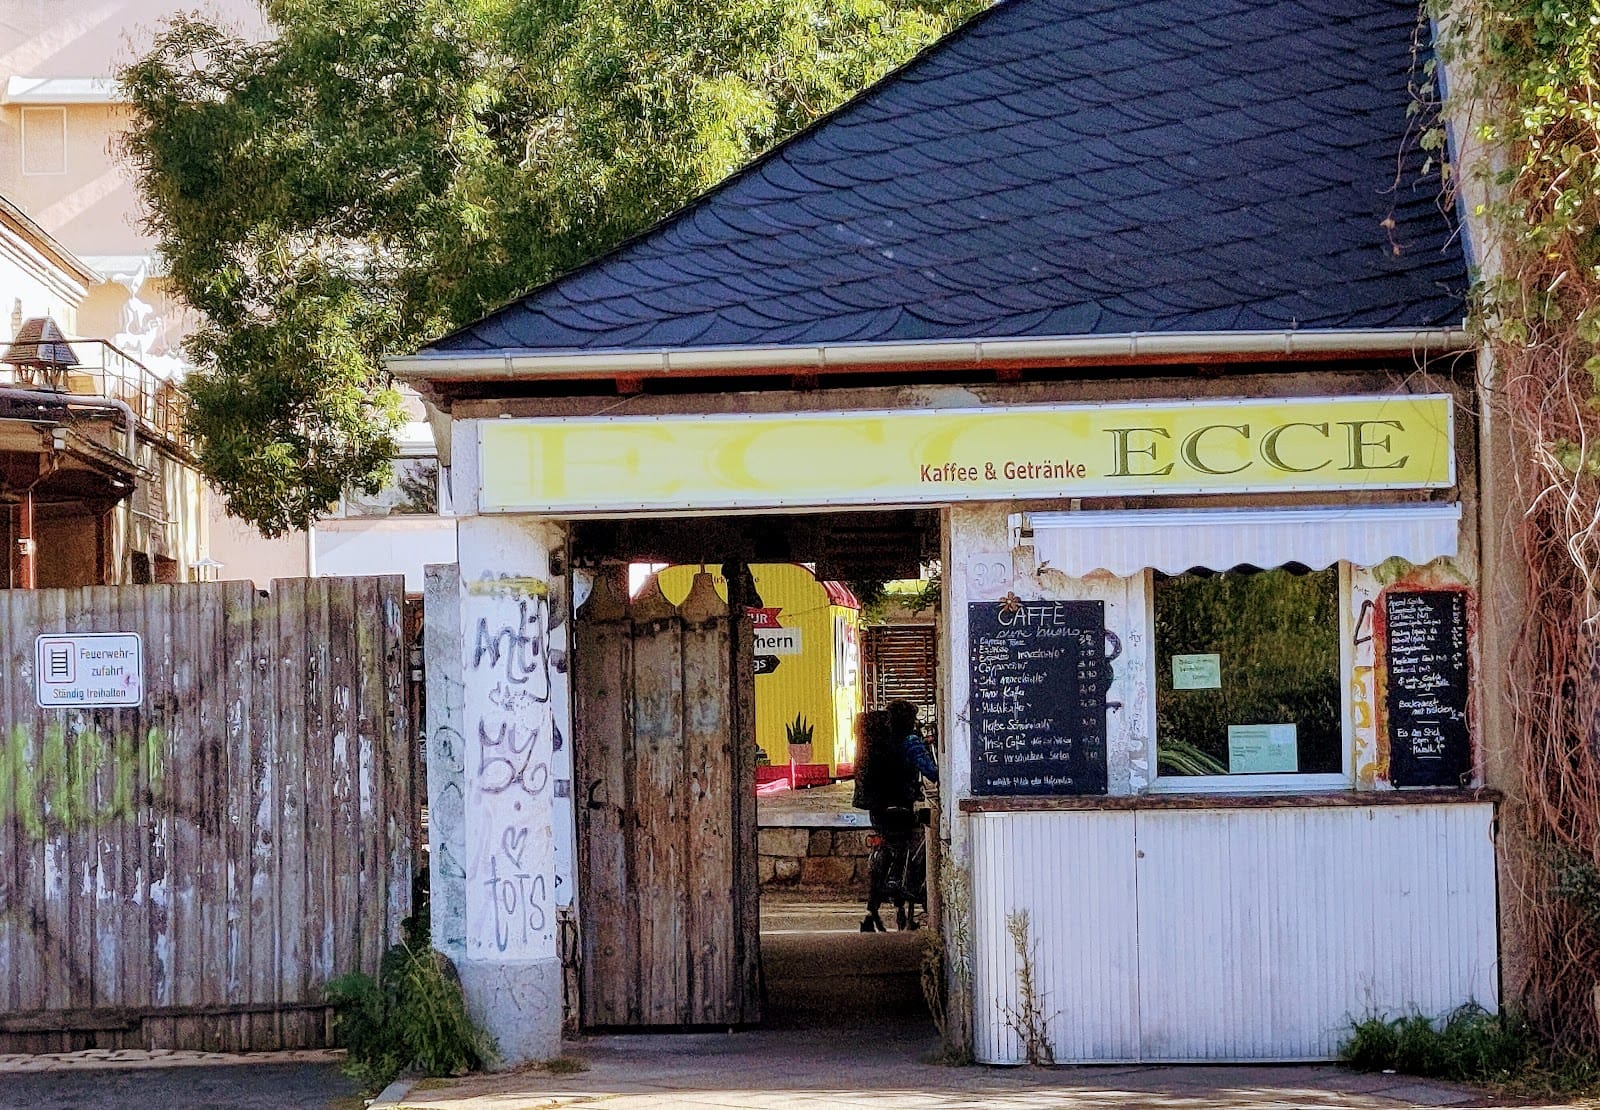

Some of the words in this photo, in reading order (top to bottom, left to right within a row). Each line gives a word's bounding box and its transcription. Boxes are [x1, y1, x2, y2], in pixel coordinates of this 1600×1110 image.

[1102, 419, 1411, 477] ECCE
[919, 463, 978, 482] Kaffee
[984, 463, 997, 480] &
[1004, 459, 1087, 480] Getränke
[80, 647, 135, 660] Feuerwehr-
[91, 665, 124, 677] zufahrt
[52, 688, 84, 700] Ständig
[87, 688, 126, 699] freihalten
